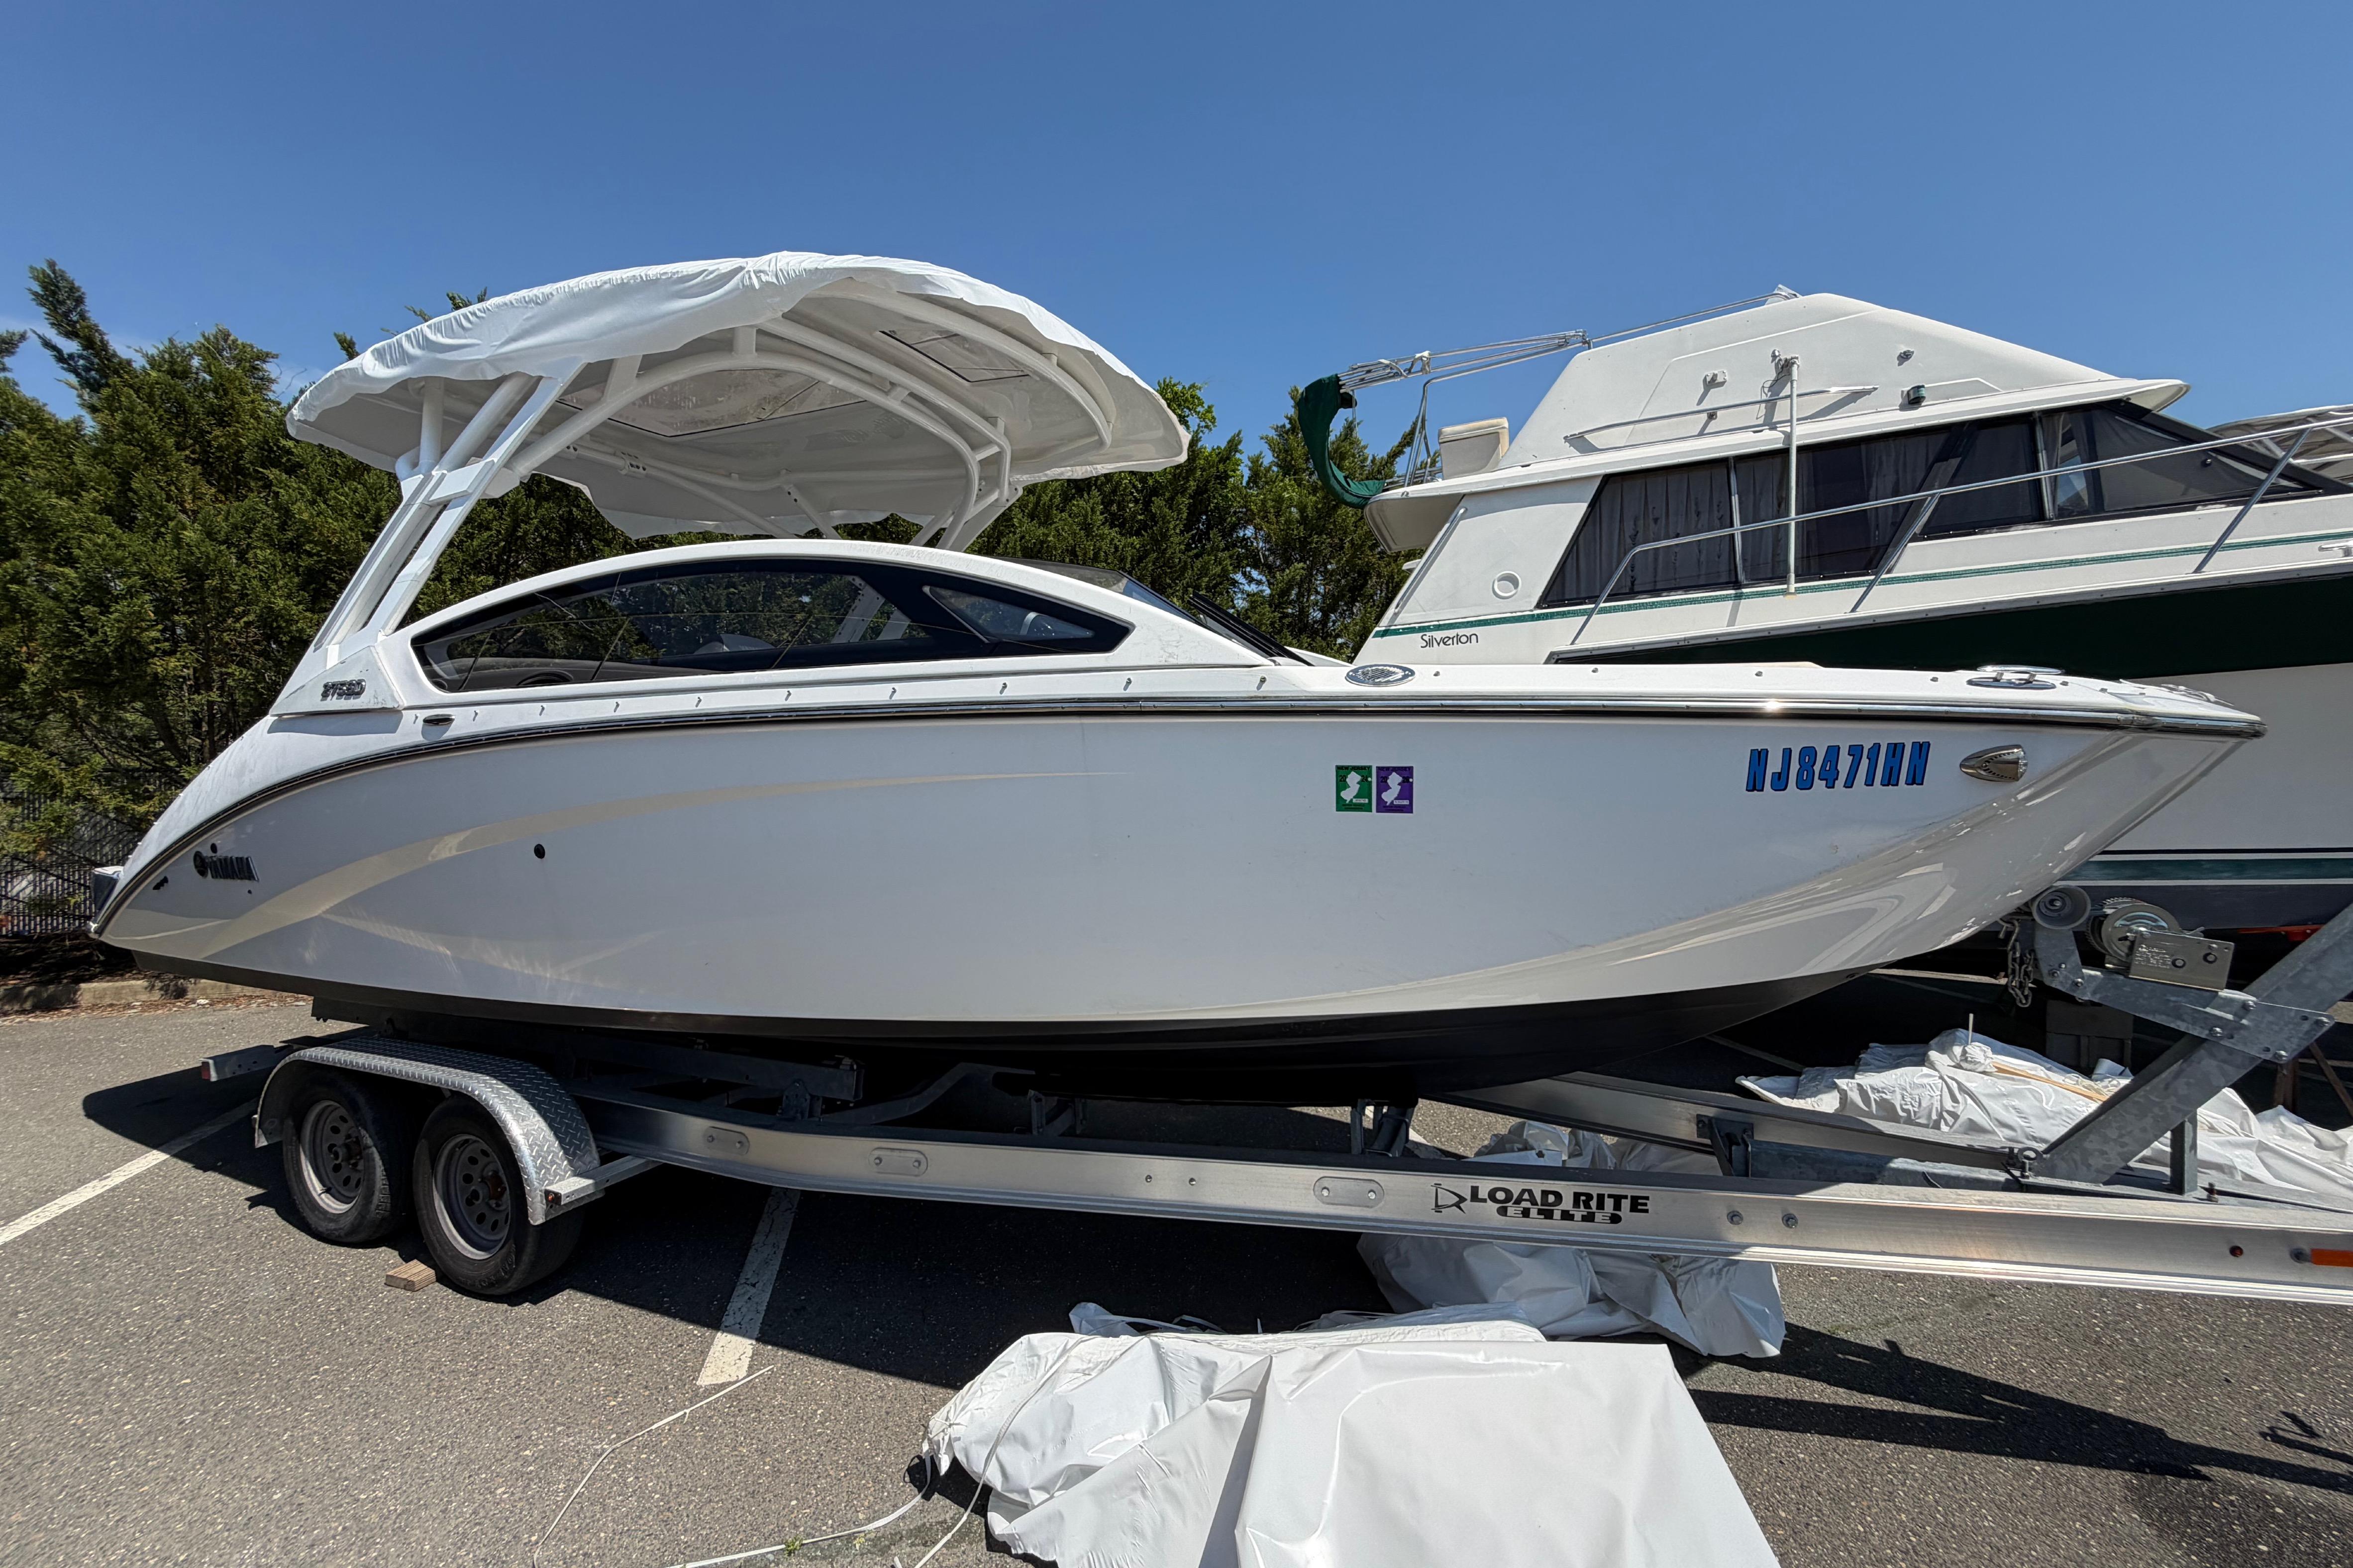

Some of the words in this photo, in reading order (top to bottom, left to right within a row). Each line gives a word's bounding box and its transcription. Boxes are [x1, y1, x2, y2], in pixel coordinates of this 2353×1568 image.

[1420, 632, 1479, 648] Silverton
[1470, 1185, 1563, 1207] LOAD
[1572, 1191, 1650, 1214] RITE
[1506, 1206, 1612, 1223] ELITE
